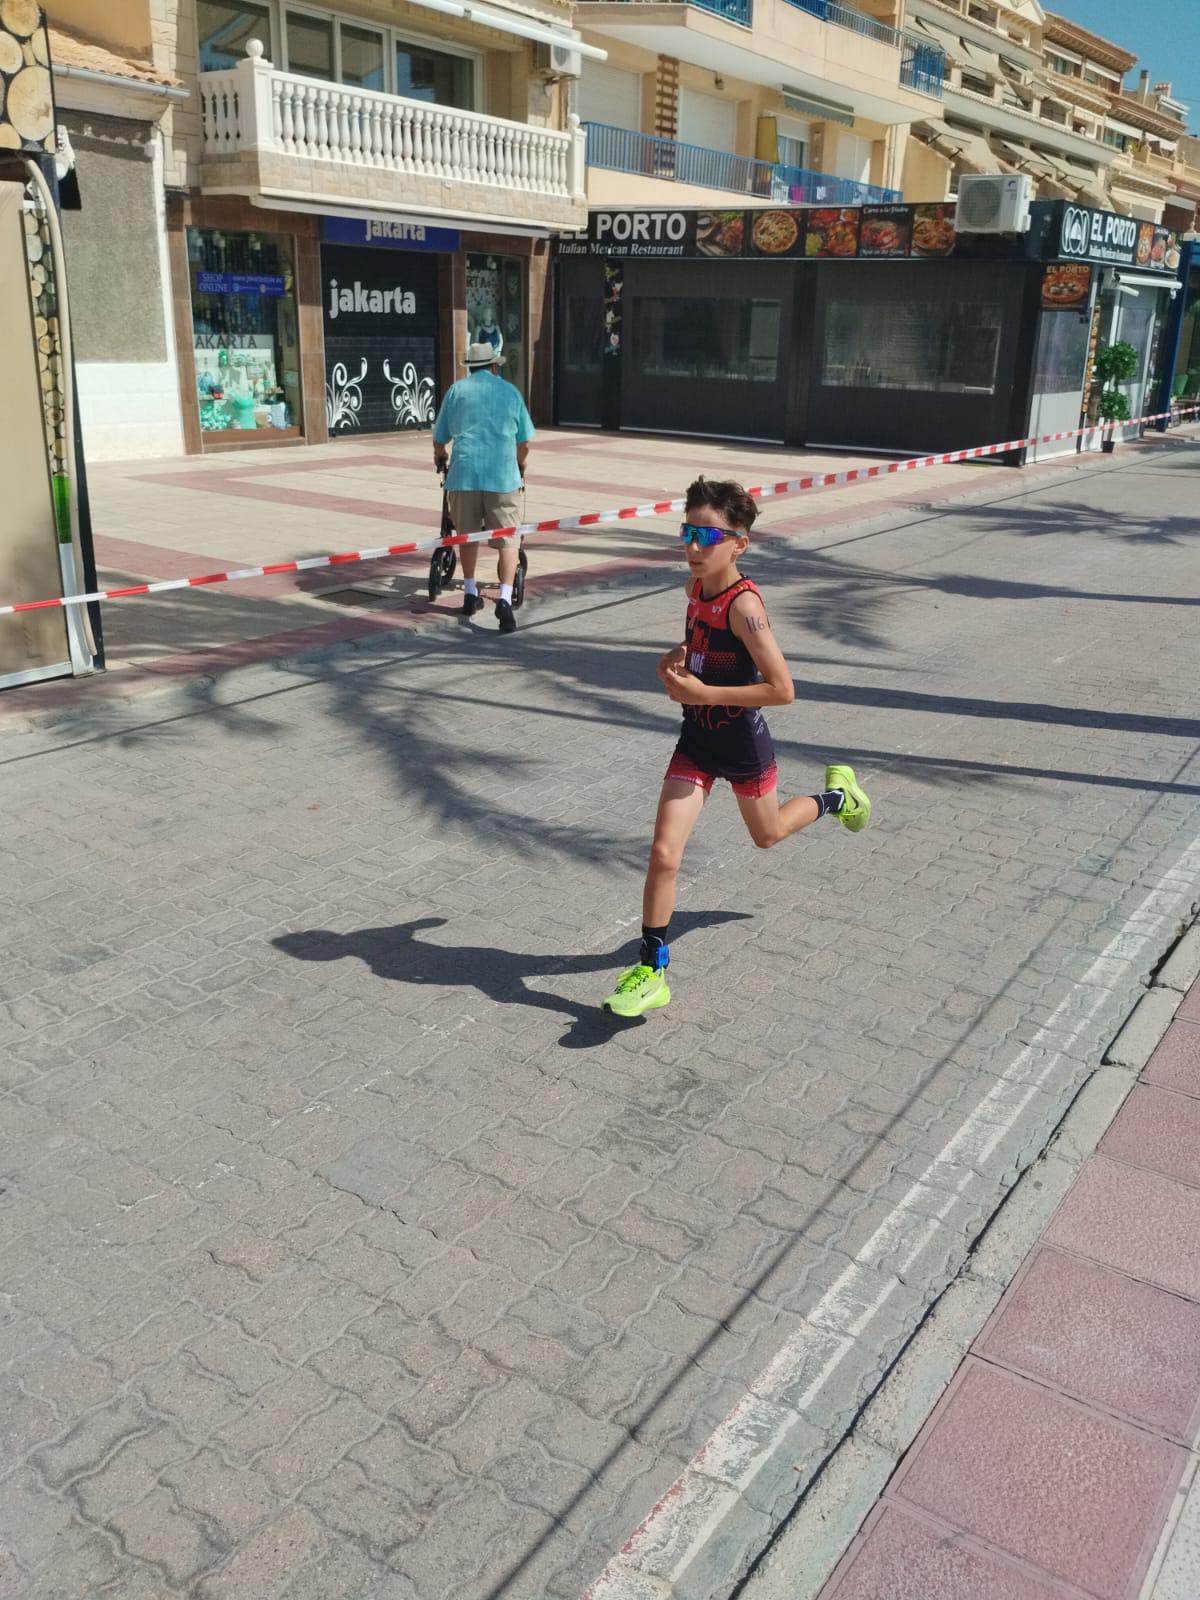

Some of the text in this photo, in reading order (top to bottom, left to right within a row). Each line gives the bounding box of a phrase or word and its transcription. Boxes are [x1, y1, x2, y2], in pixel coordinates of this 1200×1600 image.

[596, 213, 686, 240] PORTO
[1090, 212, 1137, 247] EL PORTO
[559, 243, 587, 254] Italian
[630, 243, 684, 255] Restaurant
[329, 279, 416, 319] jakarta
[195, 335, 257, 349] AKARTA
[745, 616, 765, 633] 116
